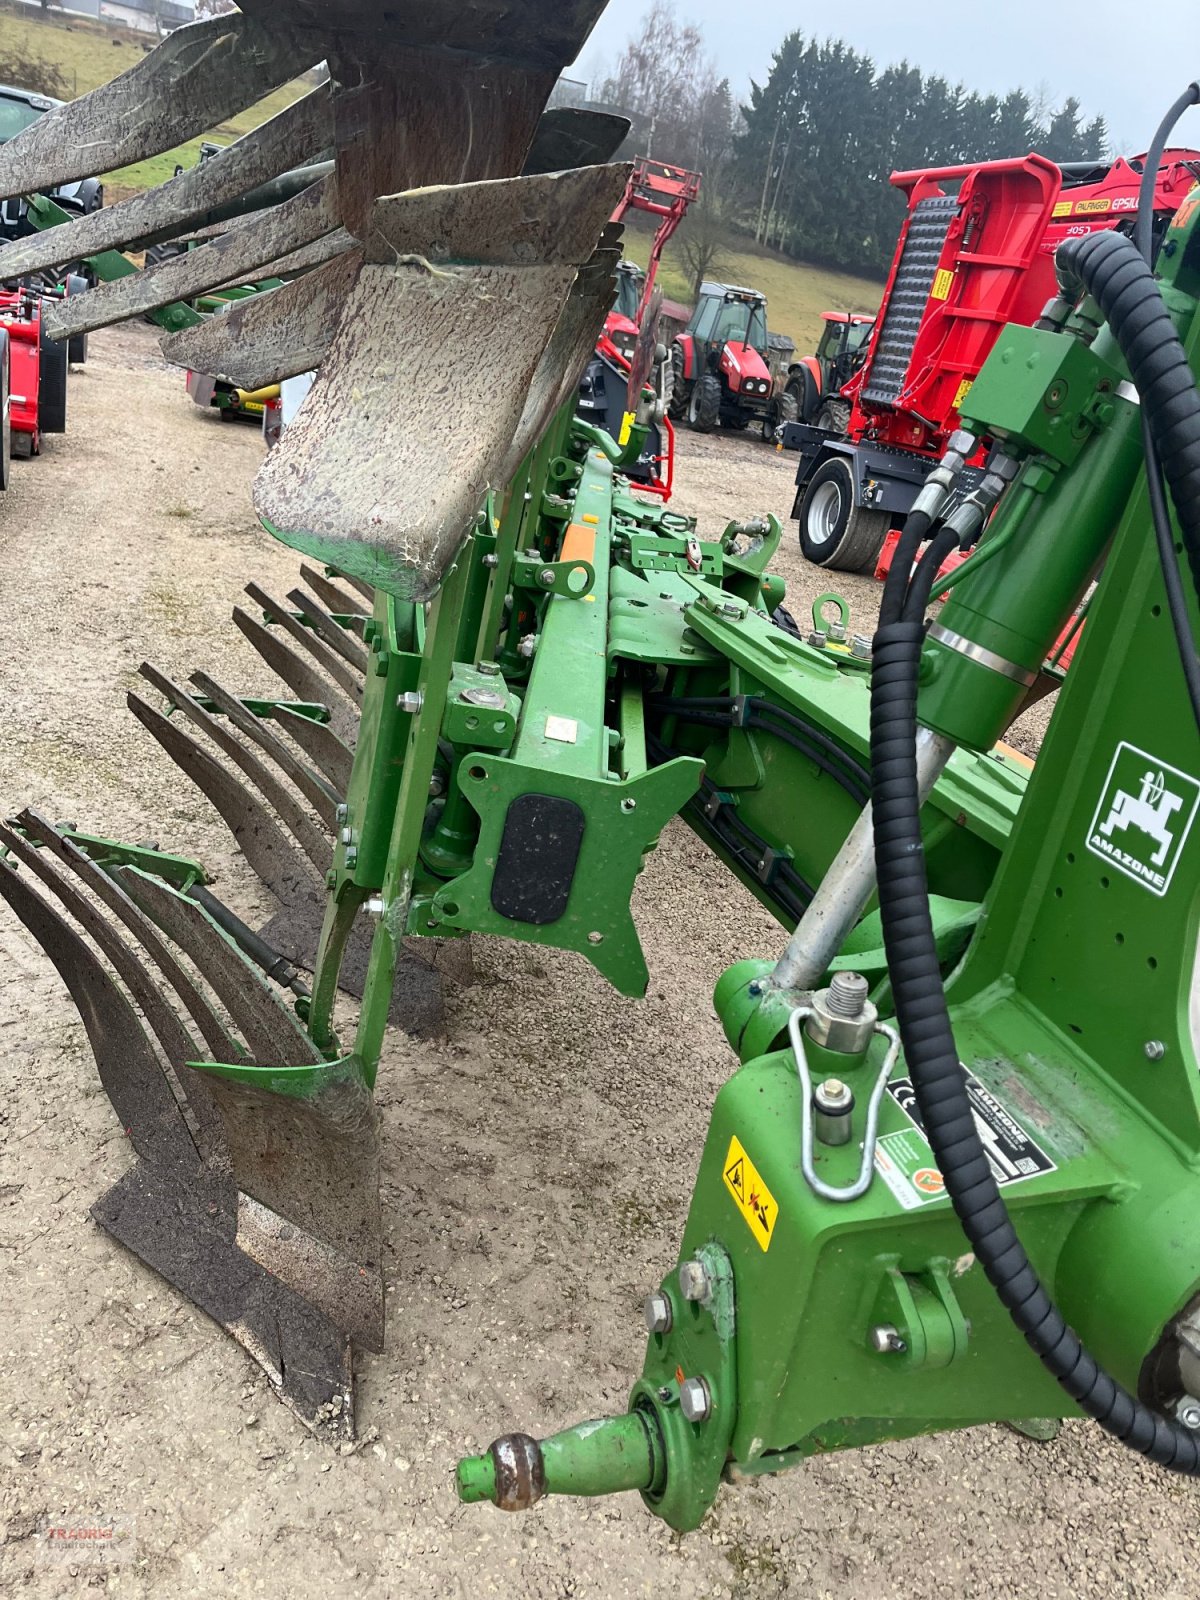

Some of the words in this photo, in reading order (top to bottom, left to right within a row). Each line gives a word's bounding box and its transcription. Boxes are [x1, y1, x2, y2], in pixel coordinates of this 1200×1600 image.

[1077, 201, 1109, 211] PALFINGER
[1091, 835, 1165, 887] AMAZONE
[973, 1087, 1029, 1144] AMAZONE
